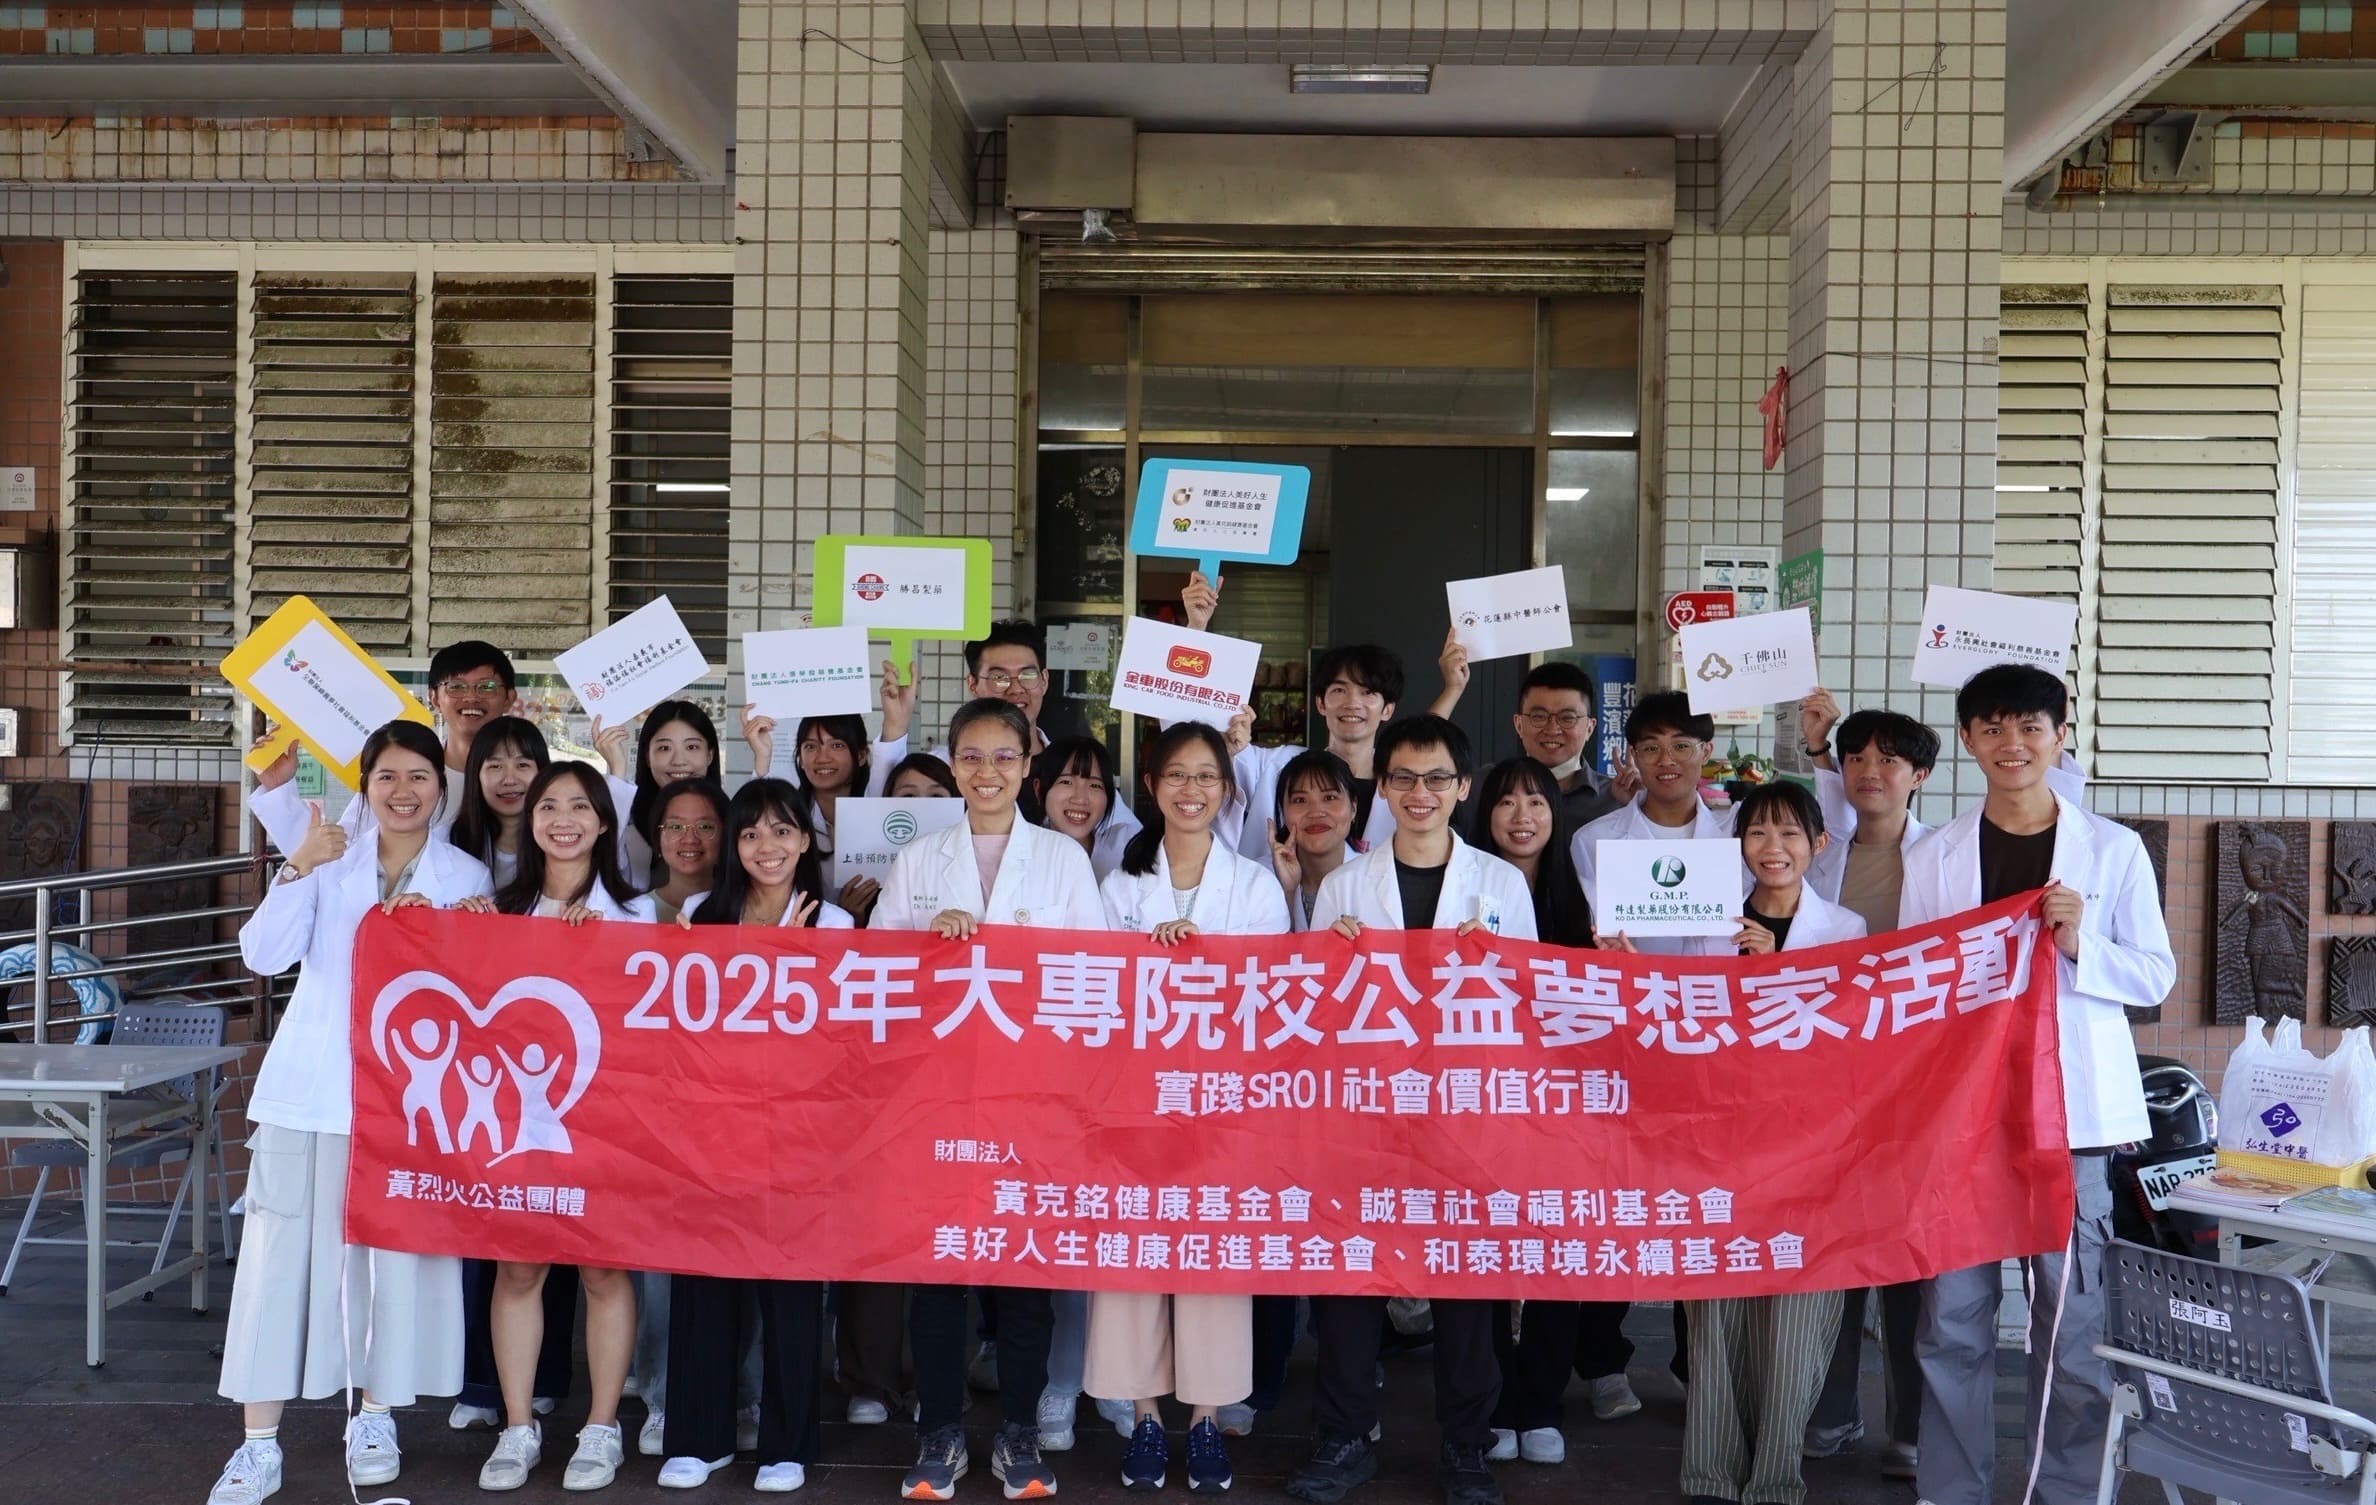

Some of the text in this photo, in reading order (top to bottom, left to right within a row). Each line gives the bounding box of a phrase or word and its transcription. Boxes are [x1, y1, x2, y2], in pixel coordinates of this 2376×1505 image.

[1203, 489, 1268, 500] 財團法人美好人生
[1205, 500, 1262, 511] 健康促進基金會
[900, 584, 942, 595] 勝昌製藥
[1483, 603, 1561, 624] 花蓮縣中醫師公會
[1741, 647, 1787, 665] 千佛山
[1952, 645, 2060, 664] EVERGLORY FOUNDATION
[1123, 683, 1138, 691] KING
[1141, 686, 1154, 694] CAR
[1156, 690, 1175, 698] FOOD
[1176, 694, 1211, 706] INDUSTRIAL
[1125, 671, 1241, 706] 金車股份有限公司
[1649, 891, 1689, 900] G.M.P.
[1615, 904, 1723, 915] 科達製藥股份有限公司
[624, 910, 2041, 1055] 2025年大專院校公益夢想家活動
[1155, 1069, 1630, 1118] 實踐SROI社會價值行動
[934, 1139, 1022, 1165] 財團法人
[2245, 1138, 2309, 1160] 弘生堂中醫
[386, 1169, 586, 1217] 黃烈火公益團體
[2171, 1301, 2230, 1329] 張阿玉
